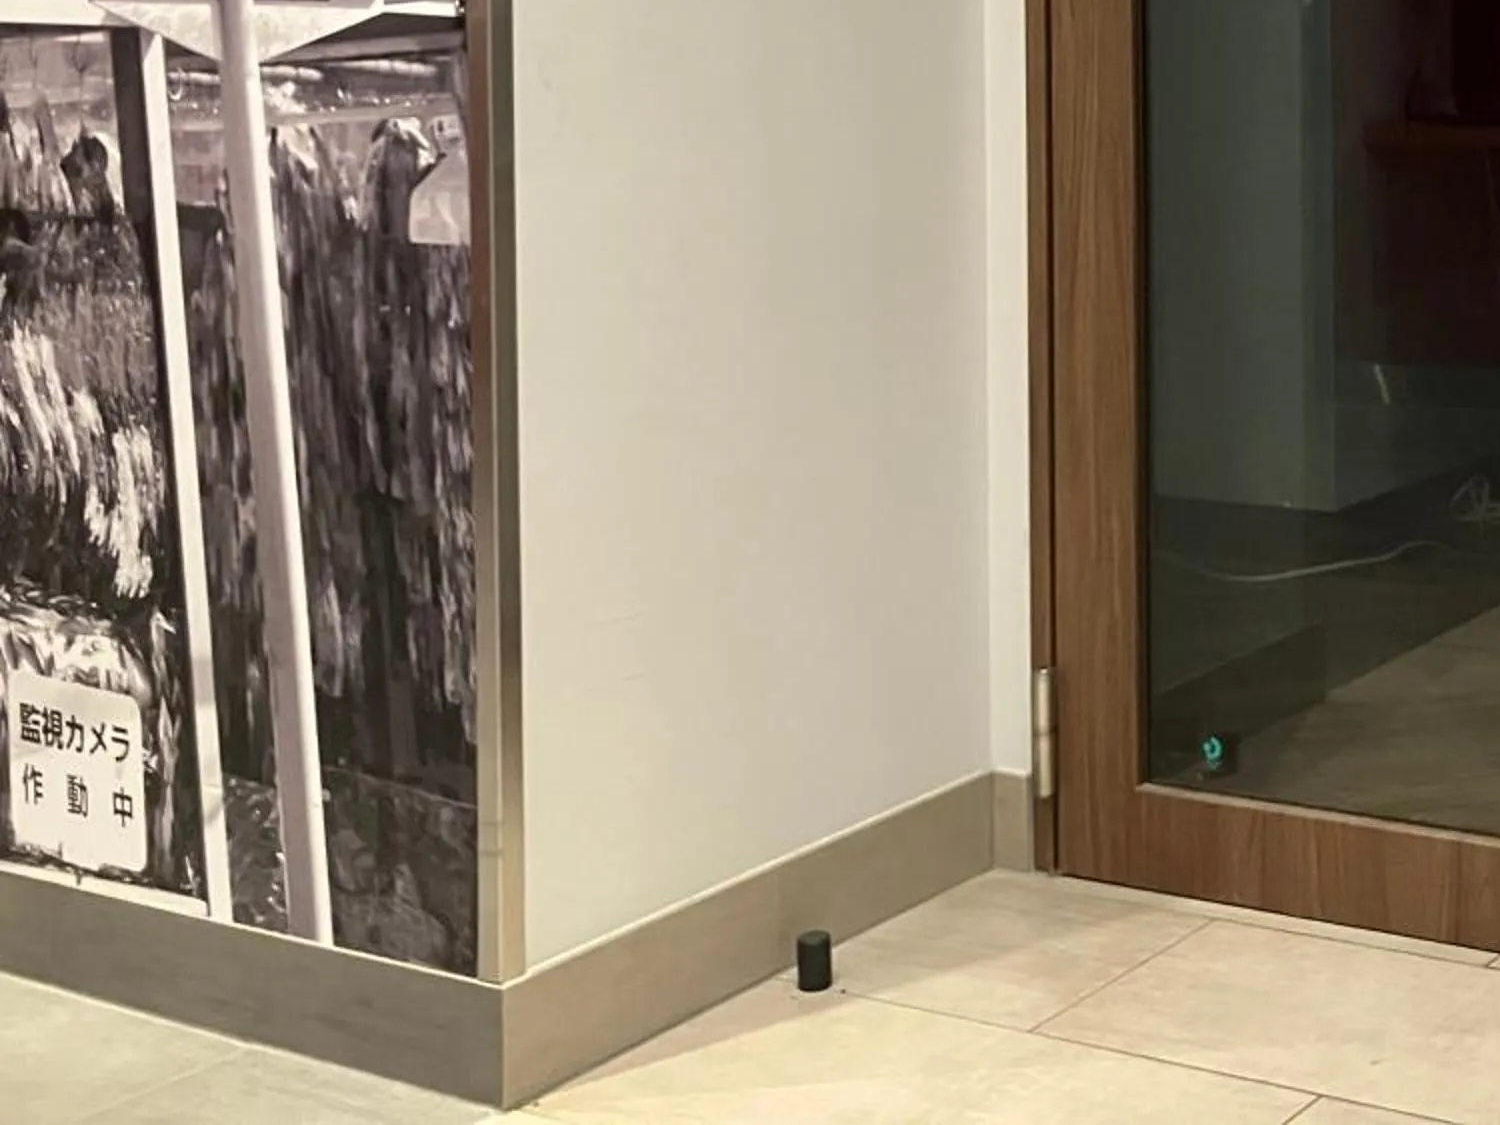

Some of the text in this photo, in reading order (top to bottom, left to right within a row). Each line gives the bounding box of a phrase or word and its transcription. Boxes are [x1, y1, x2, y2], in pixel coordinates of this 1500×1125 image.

[18, 701, 131, 763] 監視カメラ
